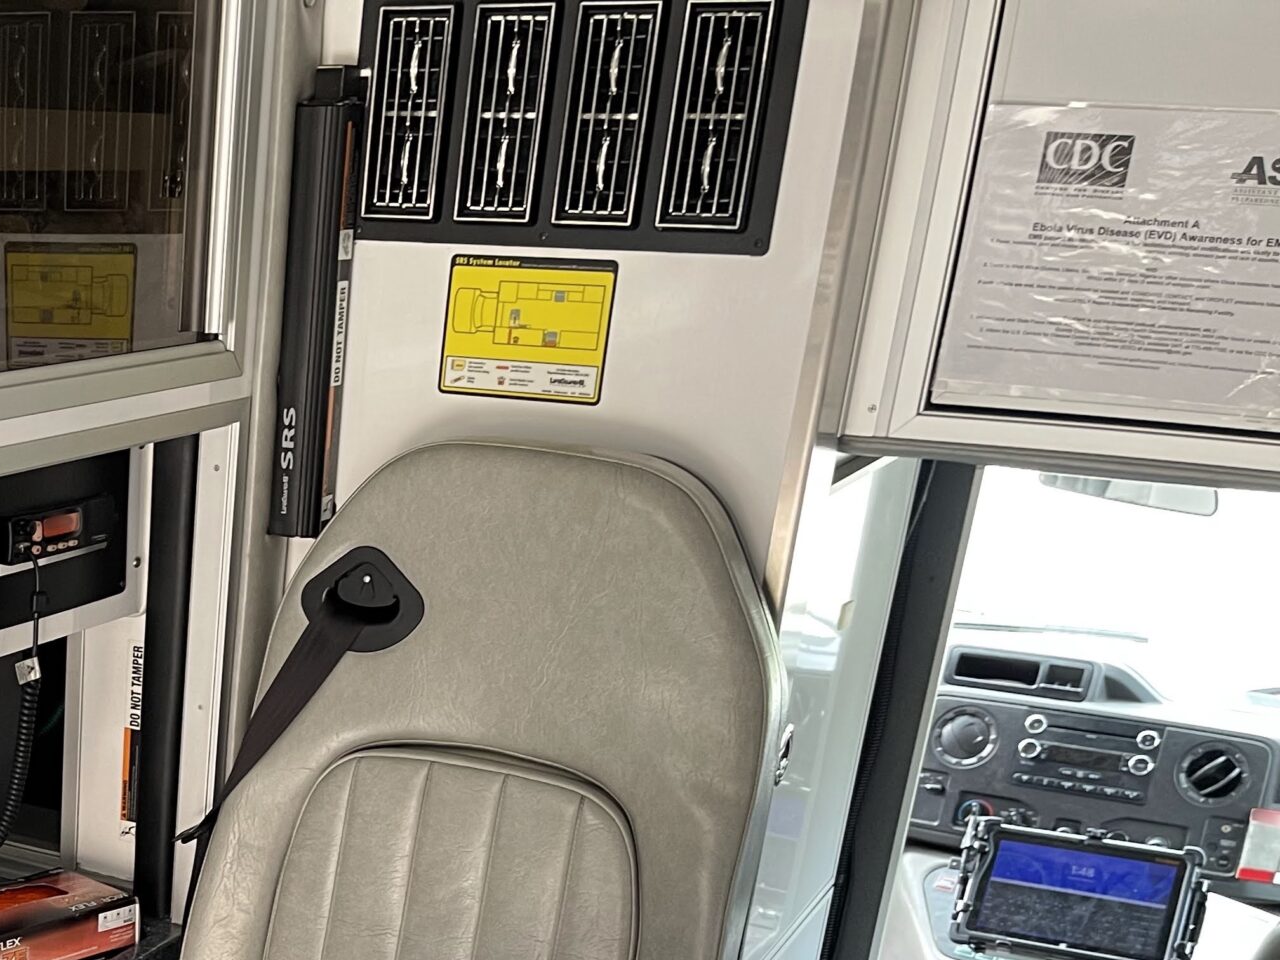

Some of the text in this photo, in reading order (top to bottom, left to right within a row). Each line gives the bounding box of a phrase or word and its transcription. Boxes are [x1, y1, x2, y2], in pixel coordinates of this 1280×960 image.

[1046, 138, 1129, 172] CDC
[1032, 222, 1063, 233] Ebola
[1066, 225, 1095, 235] Virus
[1097, 227, 1142, 239] Disease
[1144, 229, 1178, 242] (EVD)
[1179, 232, 1243, 246] Awareness
[1246, 236, 1263, 247] for
[1192, 219, 1201, 230] A
[469, 257, 494, 267] System
[495, 258, 520, 267] Locator
[333, 286, 347, 384] DO NOT TAMPER
[280, 407, 296, 470] SRS
[130, 645, 143, 727] DO NOT TAMPER
